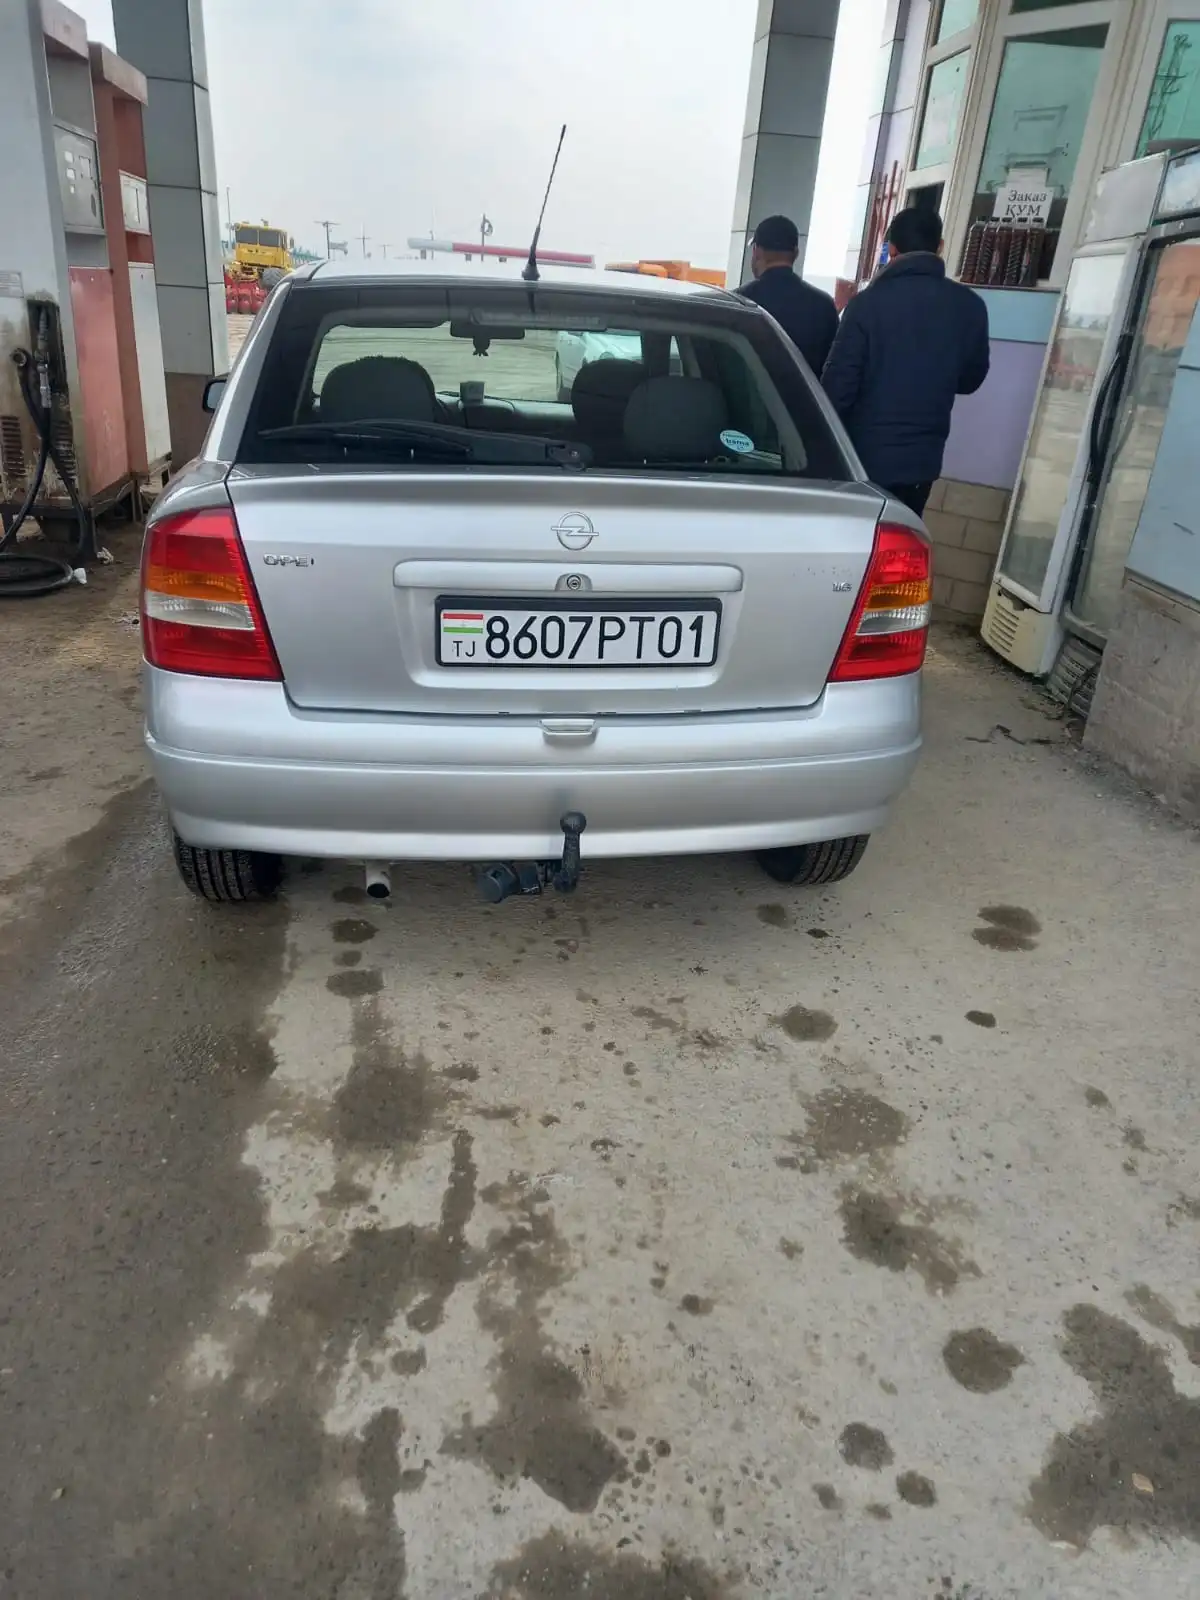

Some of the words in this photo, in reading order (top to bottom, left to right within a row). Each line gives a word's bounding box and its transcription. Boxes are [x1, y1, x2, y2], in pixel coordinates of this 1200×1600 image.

[1008, 189, 1048, 202] Заказ
[485, 615, 704, 660] 8607PT01
[452, 640, 476, 658] TJ
